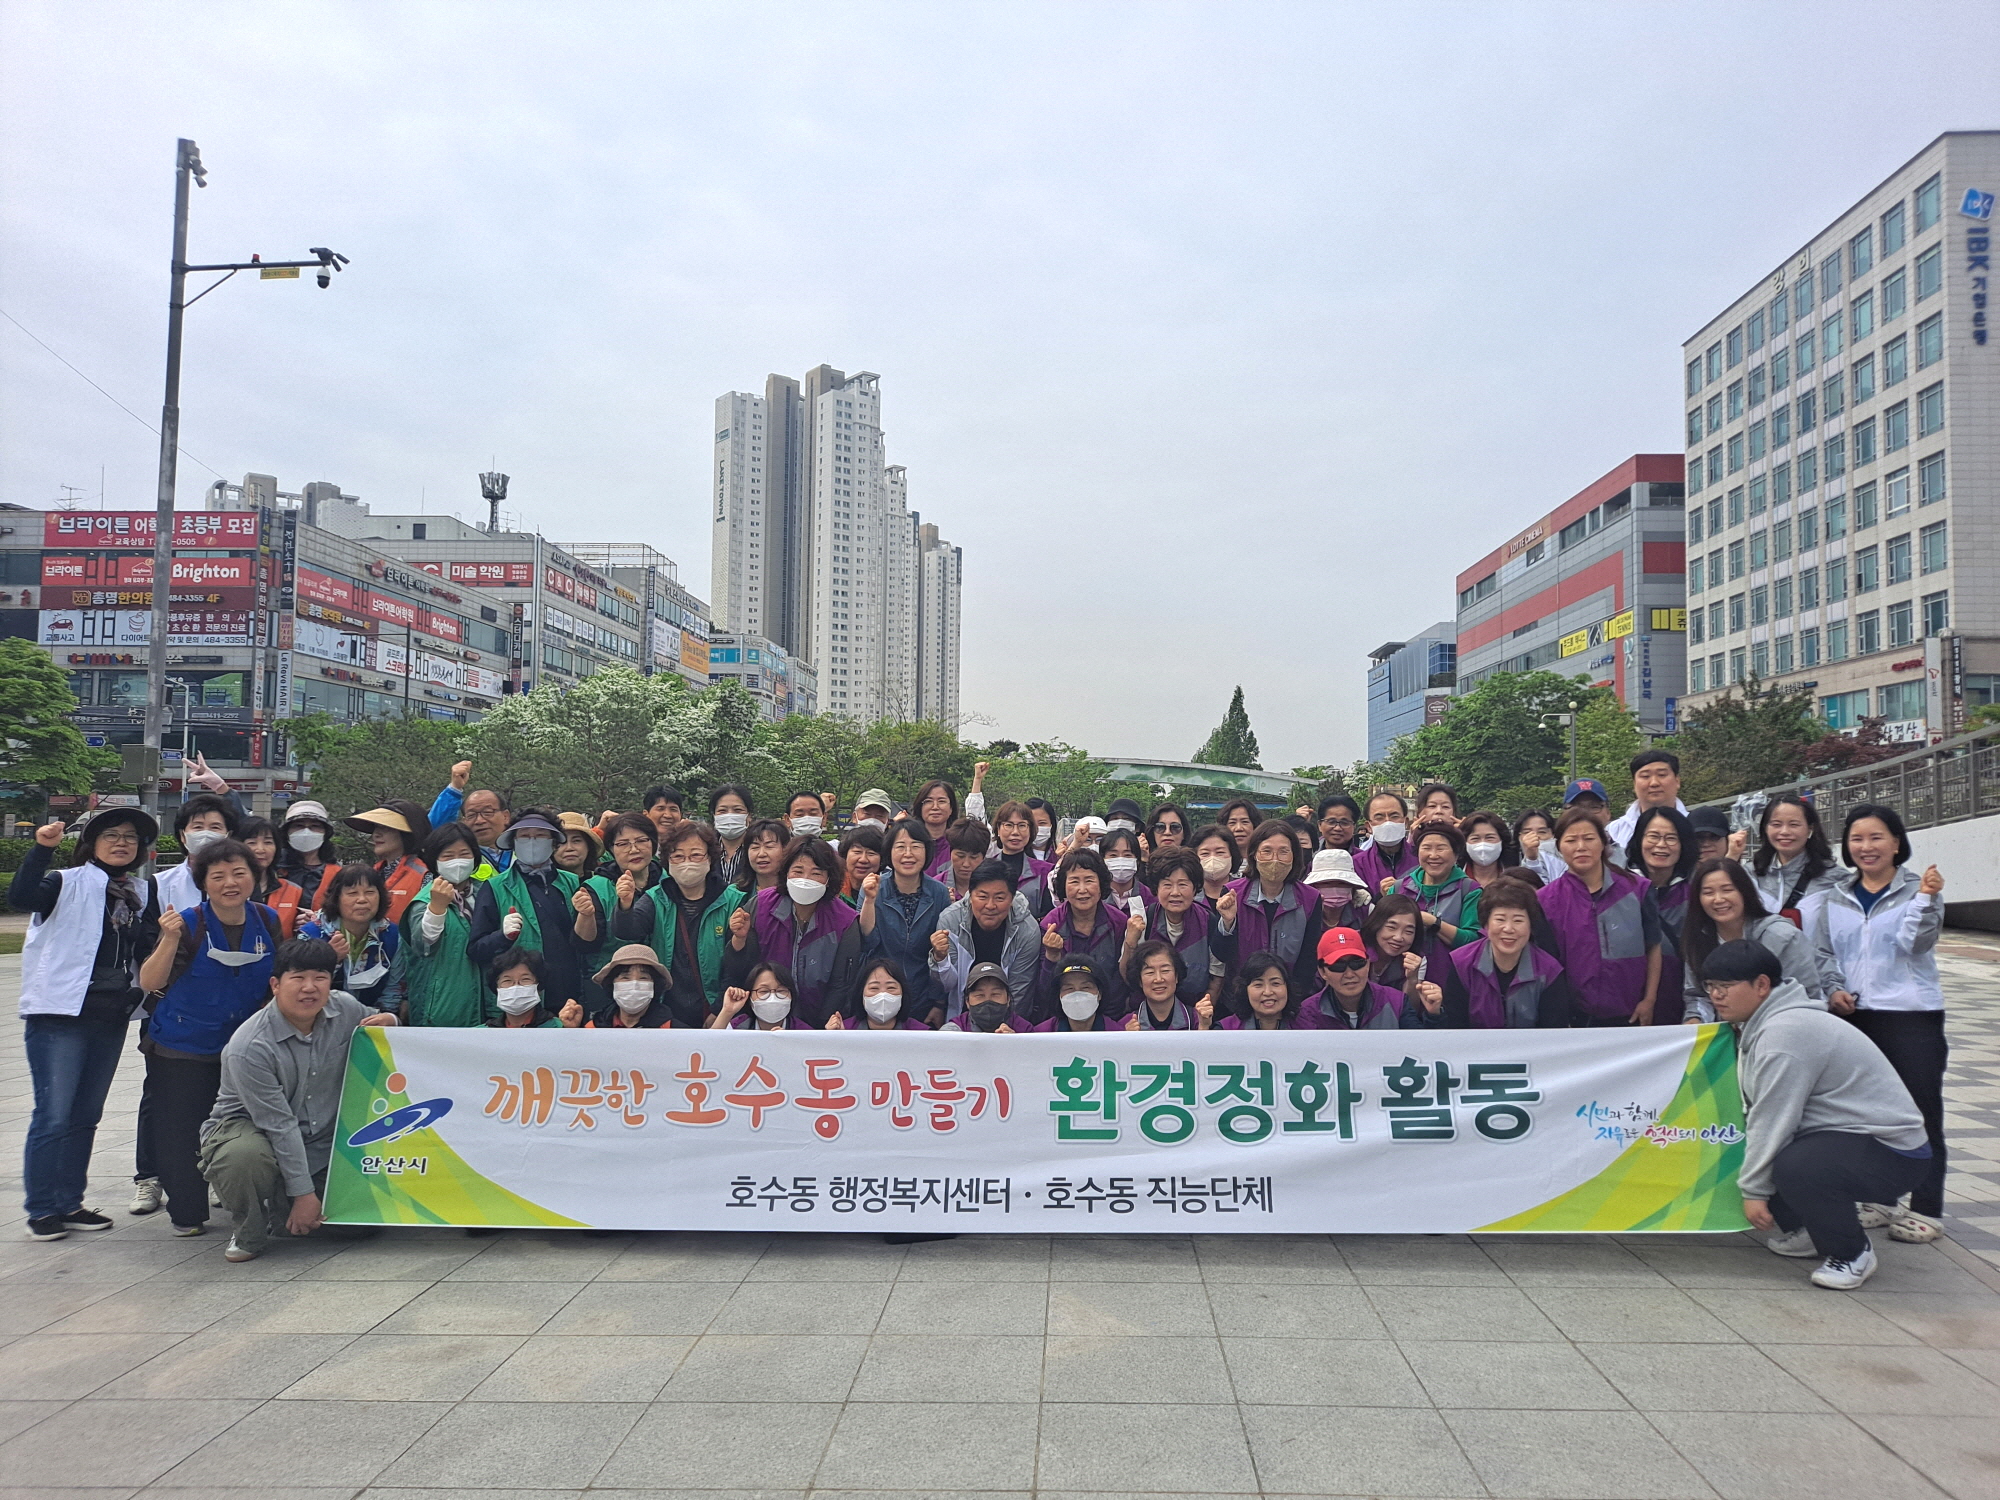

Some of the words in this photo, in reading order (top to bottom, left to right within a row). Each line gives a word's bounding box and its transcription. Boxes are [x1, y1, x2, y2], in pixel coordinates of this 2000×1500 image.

[1966, 227, 1990, 272] IBK
[1972, 276, 1988, 345] 기업은행
[58, 516, 130, 534] 브라이튼
[179, 515, 222, 535] 초등부
[226, 517, 255, 535] 모집
[114, 537, 146, 546] 교육상담
[1510, 537, 1525, 554] LOTTE
[45, 565, 83, 577] 브라이튼
[172, 562, 240, 583] Brighton
[387, 567, 415, 590] 브라이튼
[452, 565, 477, 579] 미술
[479, 565, 504, 579] 학원
[92, 591, 154, 605] 총명한의원
[206, 593, 221, 603] 4F
[372, 597, 414, 623] 브라이튼어학원
[432, 616, 457, 636] Brighton
[1617, 621, 1632, 634] TENNIS
[45, 633, 75, 642] 교통사고
[177, 636, 184, 645] 및
[185, 636, 200, 645] 문의
[204, 636, 246, 644] 484-3355
[278, 685, 288, 707] HAIR
[484, 1065, 655, 1131] 깨끗한
[665, 1051, 857, 1141] 호수동
[869, 1068, 1011, 1133] 만들기
[1048, 1055, 1363, 1145] 환경정화
[1379, 1056, 1540, 1140] 활동
[1576, 1100, 1624, 1128] 시민과
[1594, 1126, 1640, 1149] 자유로운
[1644, 1124, 1697, 1148] 혁신도시
[1700, 1122, 1745, 1144] 안산
[361, 1155, 428, 1174] 안산시
[726, 1175, 820, 1212] 호수동
[829, 1176, 1011, 1214] 행정복지센터
[1042, 1176, 1138, 1214] 호수동
[1146, 1176, 1274, 1214] 직능단체
